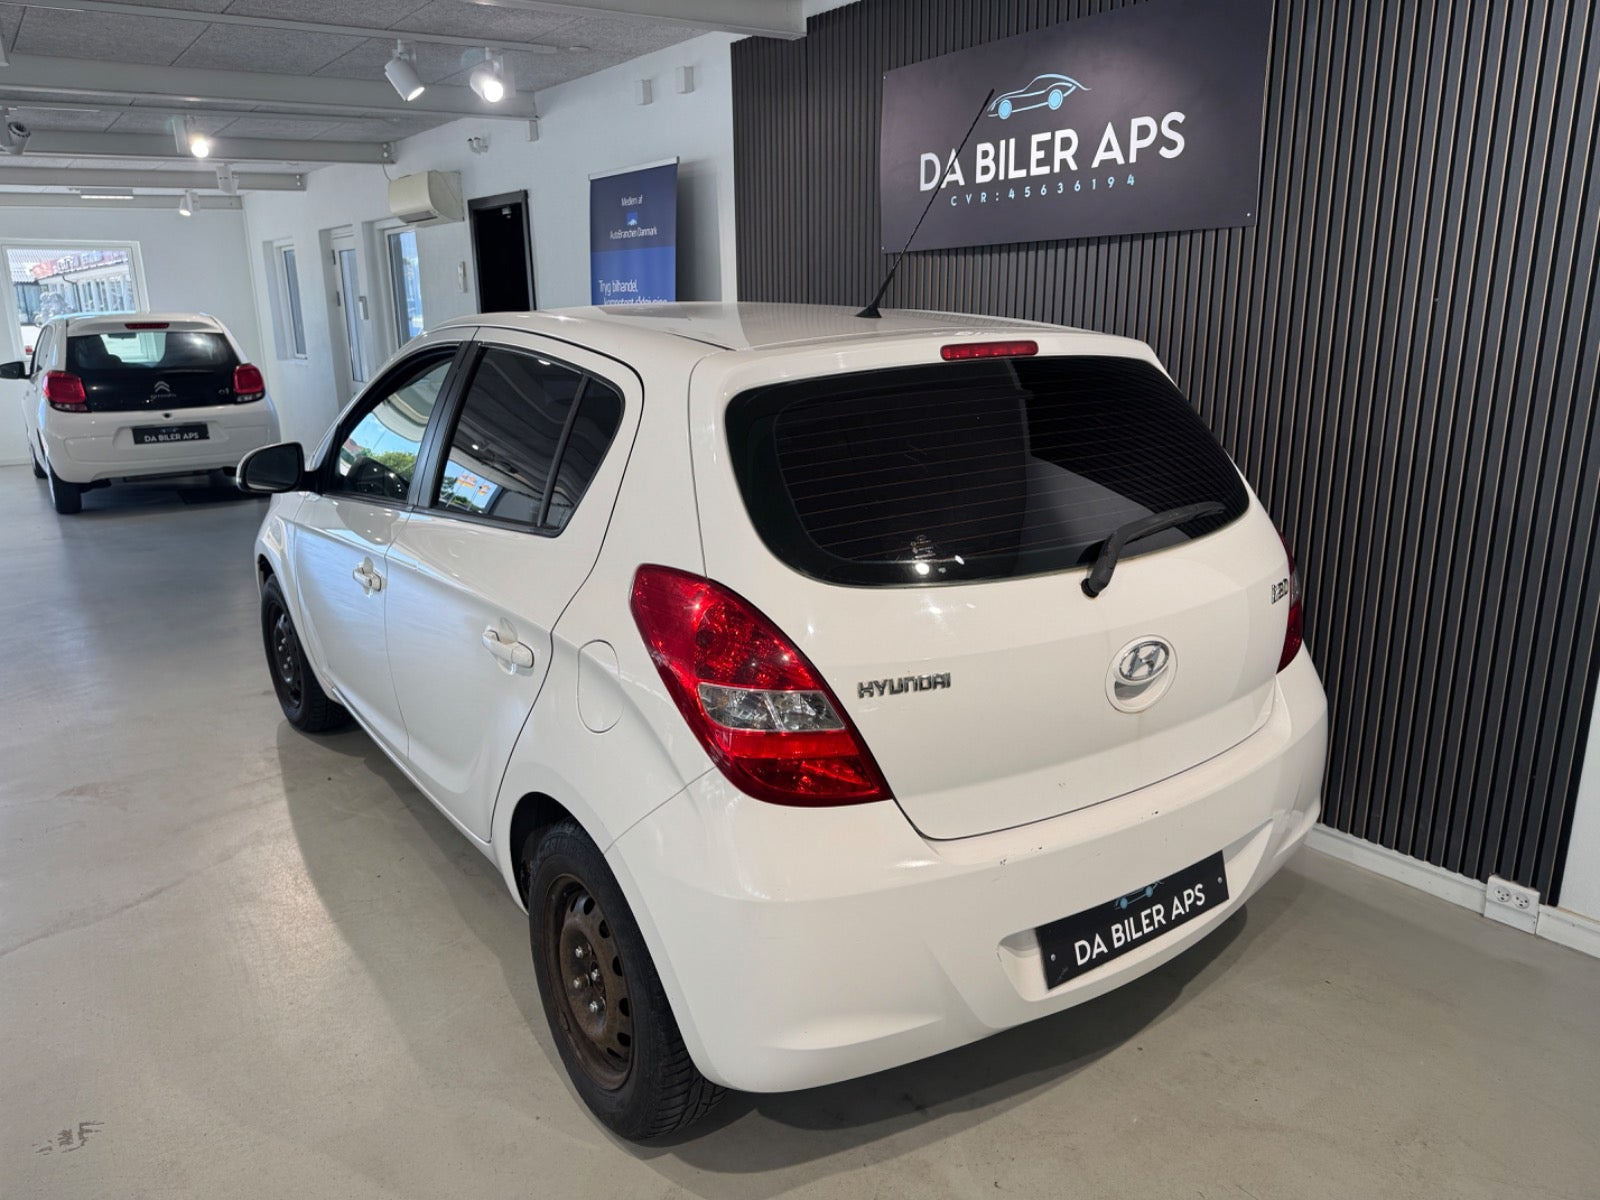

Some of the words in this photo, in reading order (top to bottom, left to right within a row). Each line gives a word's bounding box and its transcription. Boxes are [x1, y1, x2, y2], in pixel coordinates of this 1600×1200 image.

[919, 148, 965, 191] DA
[975, 128, 1079, 184] BILER
[1091, 111, 1186, 169] APS
[621, 196, 638, 206] Medlem
[598, 279, 612, 296] Tryg
[144, 435, 158, 443] DA
[158, 432, 181, 441] BILER
[183, 431, 200, 439] APS
[858, 672, 951, 699] HYUNDAI
[1073, 933, 1109, 966] DA
[1111, 903, 1167, 949] BILER
[1171, 883, 1206, 921] APS
